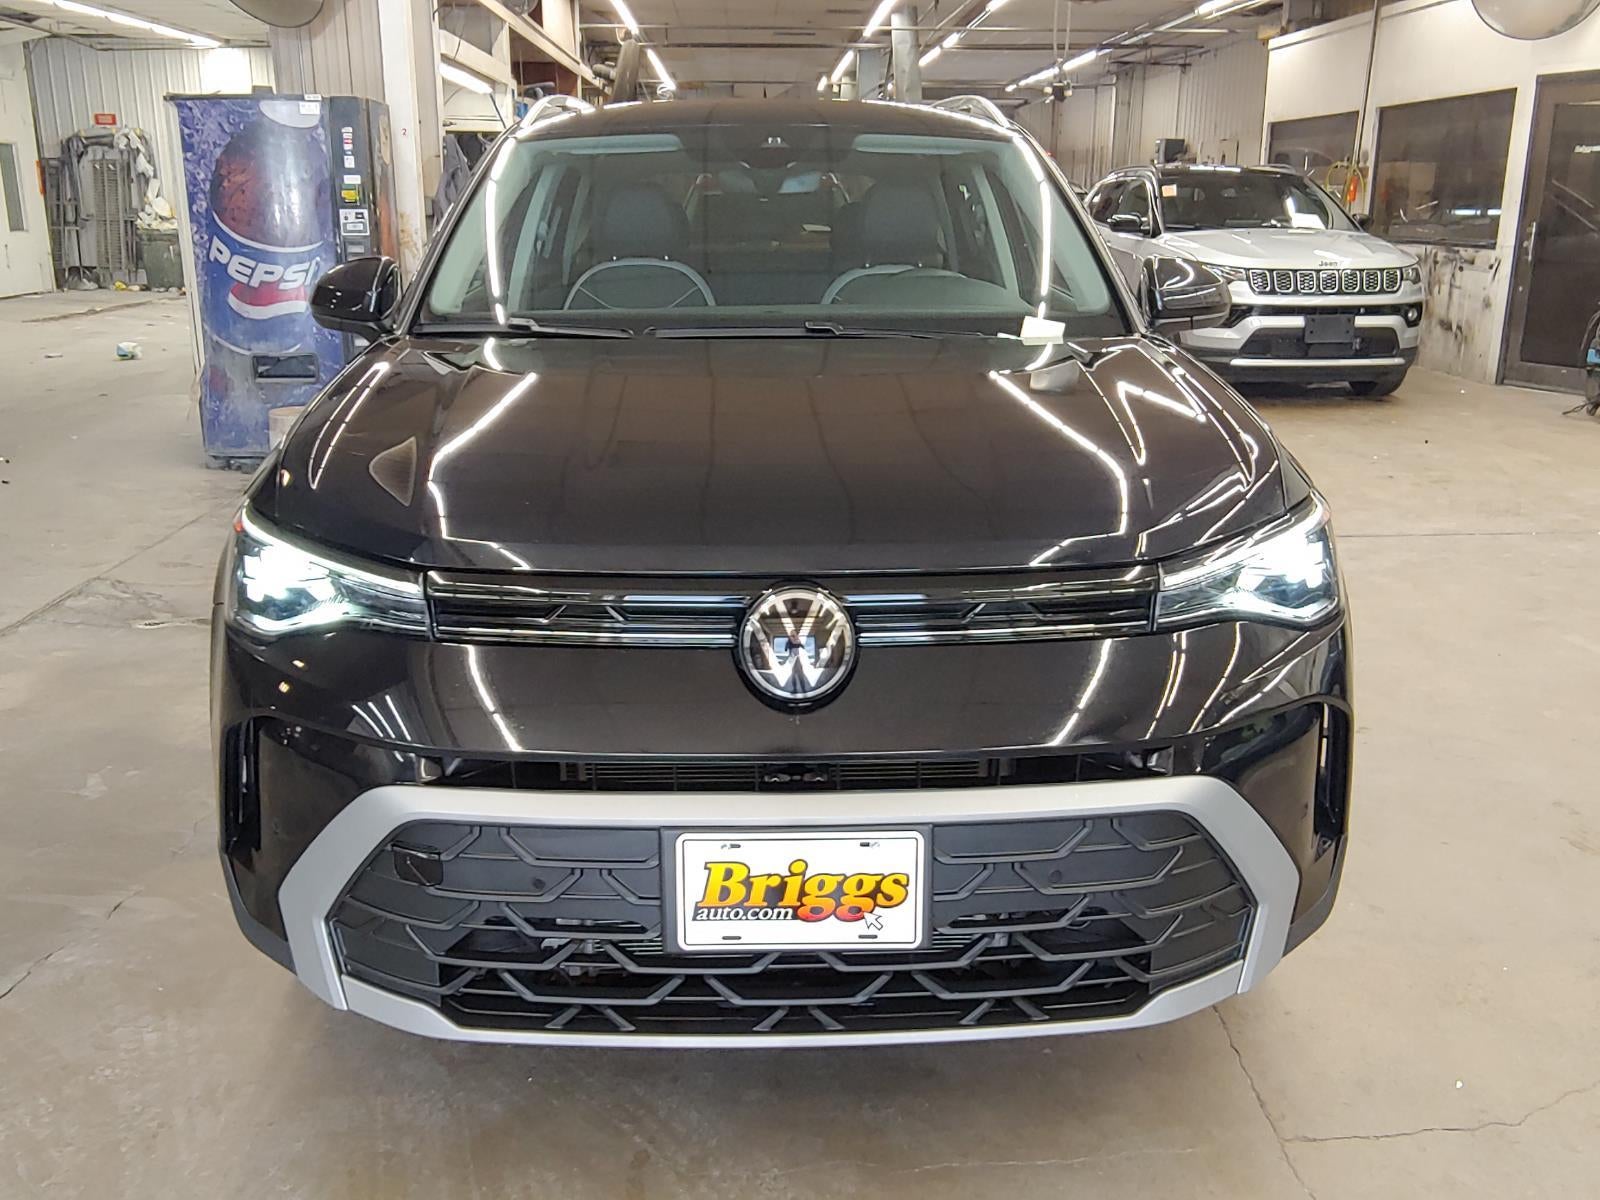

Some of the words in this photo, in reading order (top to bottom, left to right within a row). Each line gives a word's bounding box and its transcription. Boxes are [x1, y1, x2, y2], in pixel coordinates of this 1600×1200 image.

[209, 235, 321, 289] PEPSI
[695, 904, 794, 922] auto.com
[698, 859, 909, 922] Briggs
